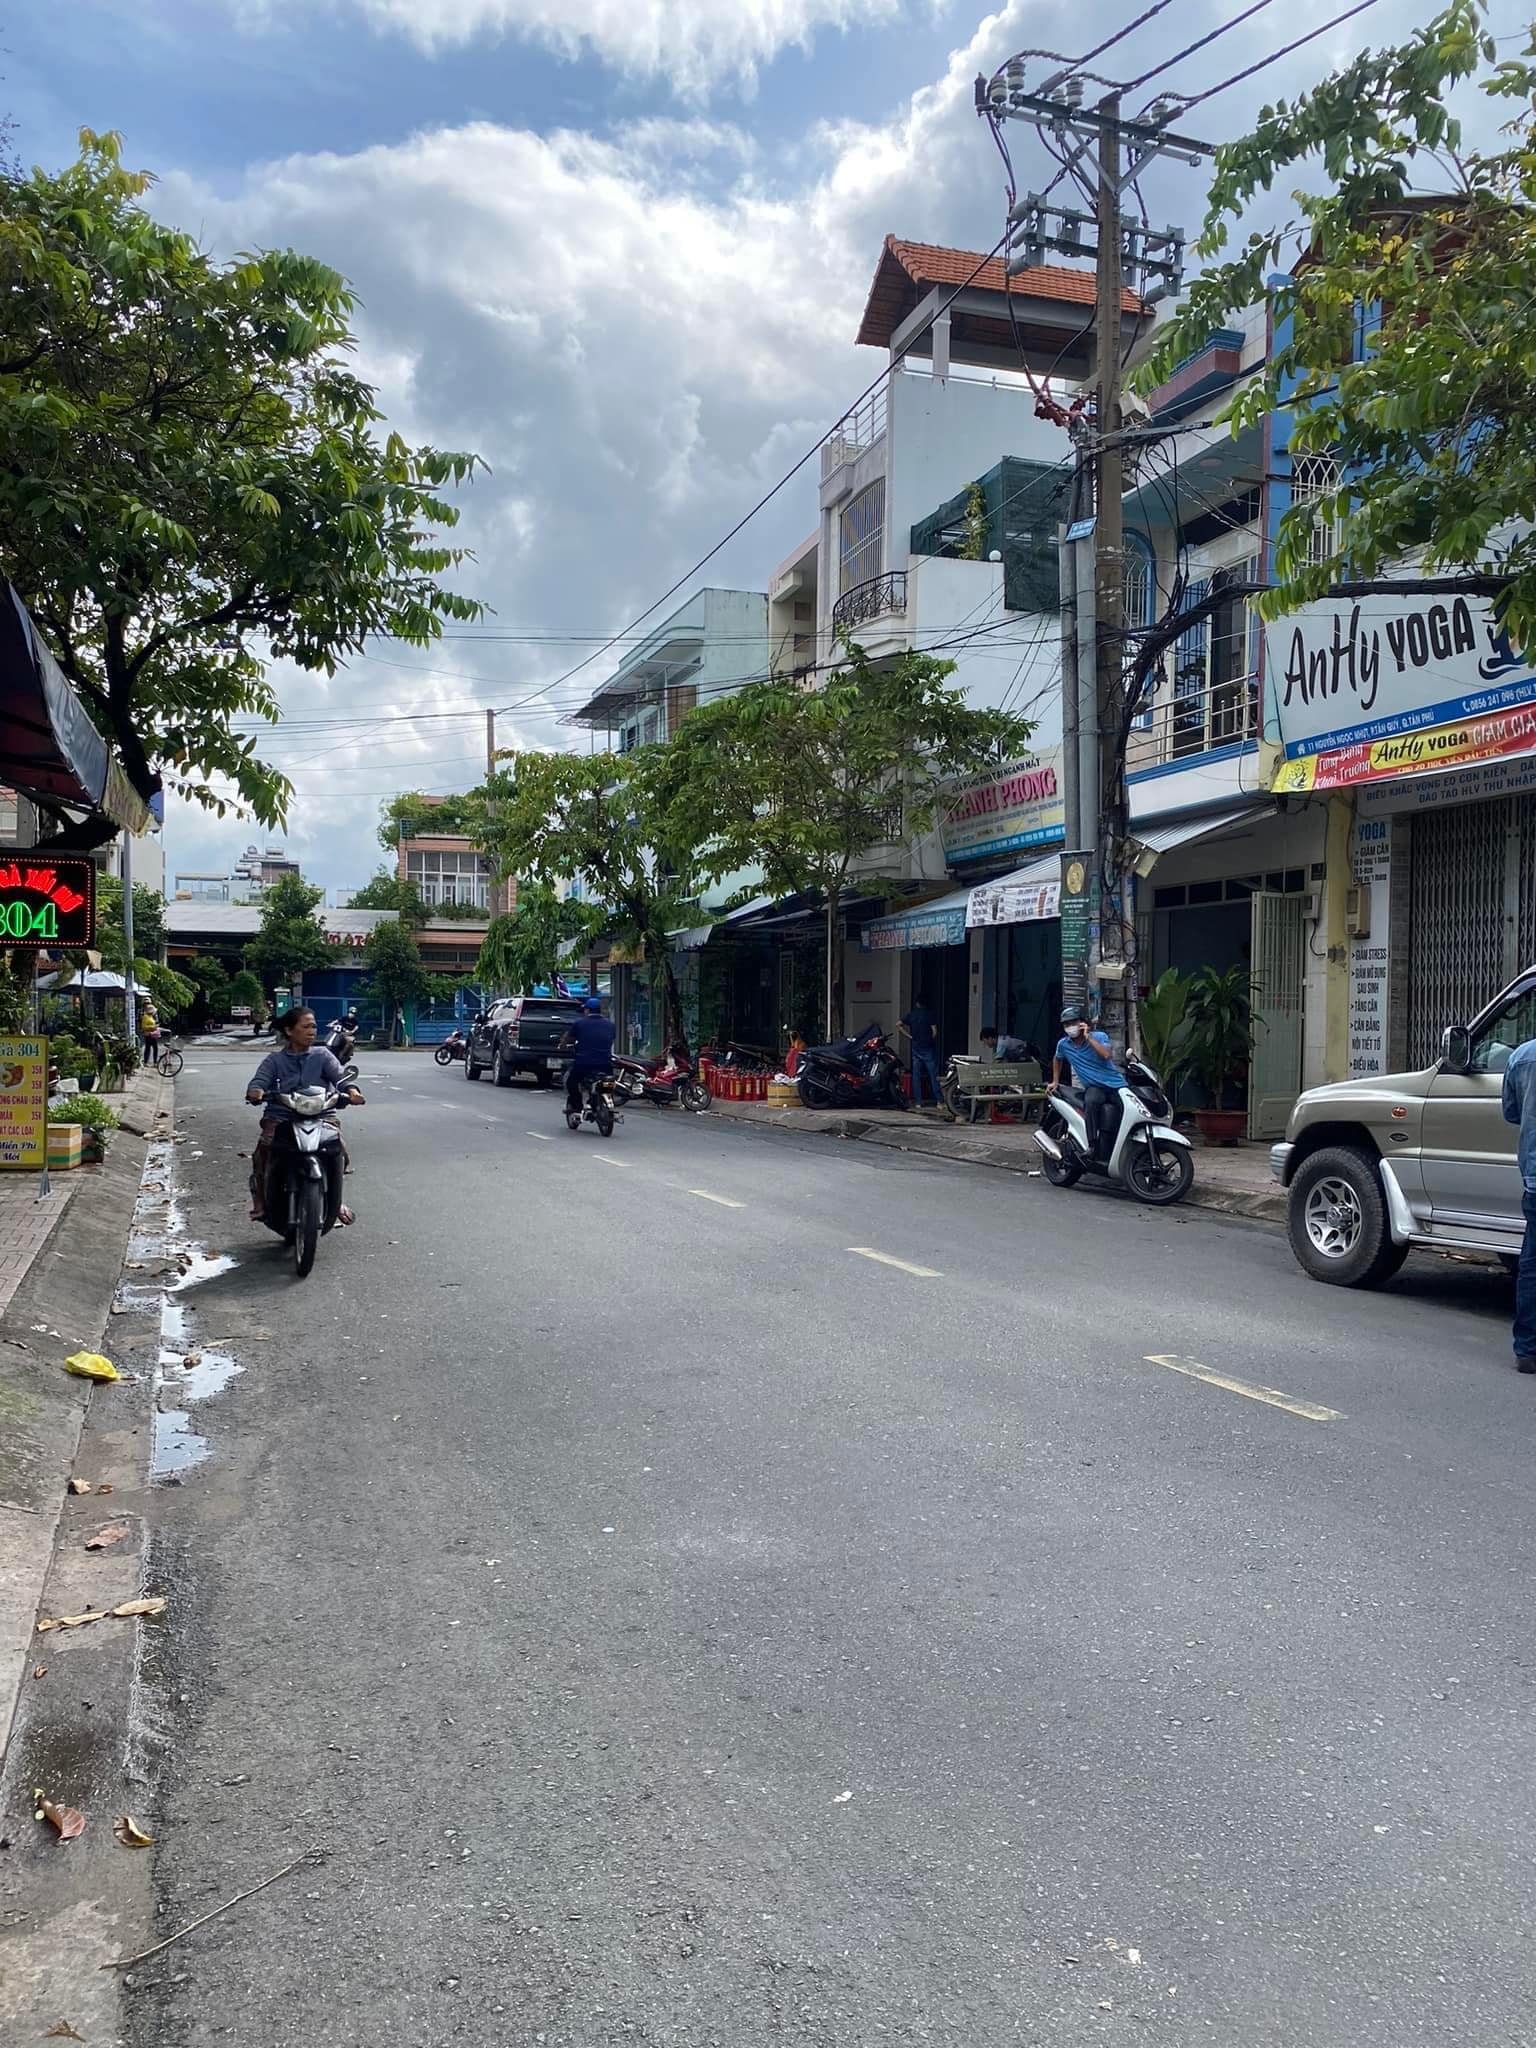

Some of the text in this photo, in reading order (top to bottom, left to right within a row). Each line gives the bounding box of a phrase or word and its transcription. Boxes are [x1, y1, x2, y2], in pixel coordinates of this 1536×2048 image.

[1283, 597, 1476, 711] AnHy YOGA
[1374, 735, 1423, 763] AnHy
[1428, 731, 1469, 751] YOGA
[1001, 767, 1057, 809] PHONG
[1462, 783, 1480, 797] HLV
[1359, 821, 1386, 842] YOGA
[18, 1043, 39, 1056] 304
